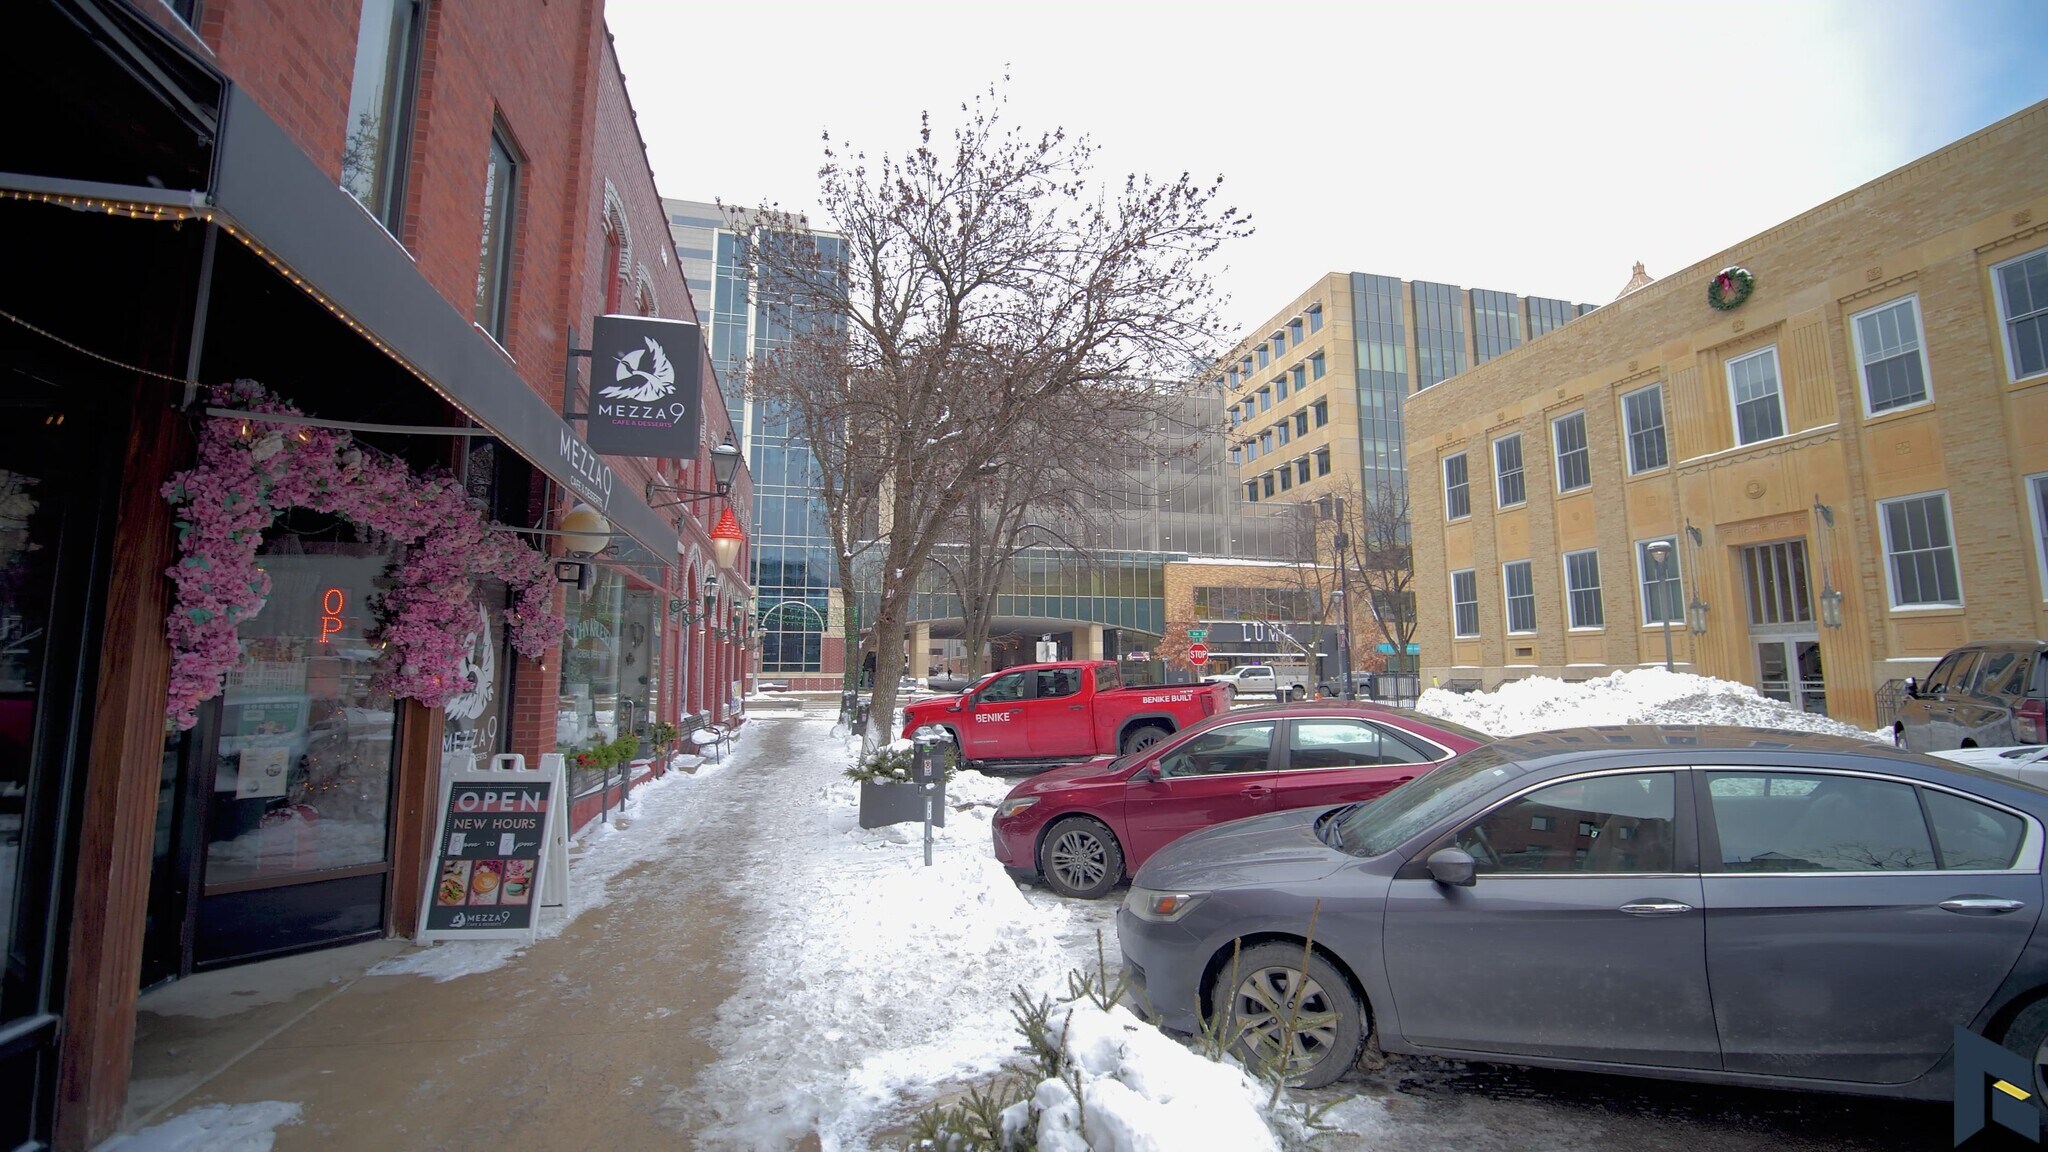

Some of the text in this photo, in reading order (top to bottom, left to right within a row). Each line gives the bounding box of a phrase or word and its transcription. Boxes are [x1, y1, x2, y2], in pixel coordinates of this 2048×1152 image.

[638, 420, 672, 428] DESSERTS
[1190, 650, 1207, 659] STOP
[1142, 694, 1193, 704] BENIKE BUILT
[975, 712, 1011, 723] BENIKE
[458, 790, 541, 813] OPEN
[453, 818, 536, 830] NEW HOURS
